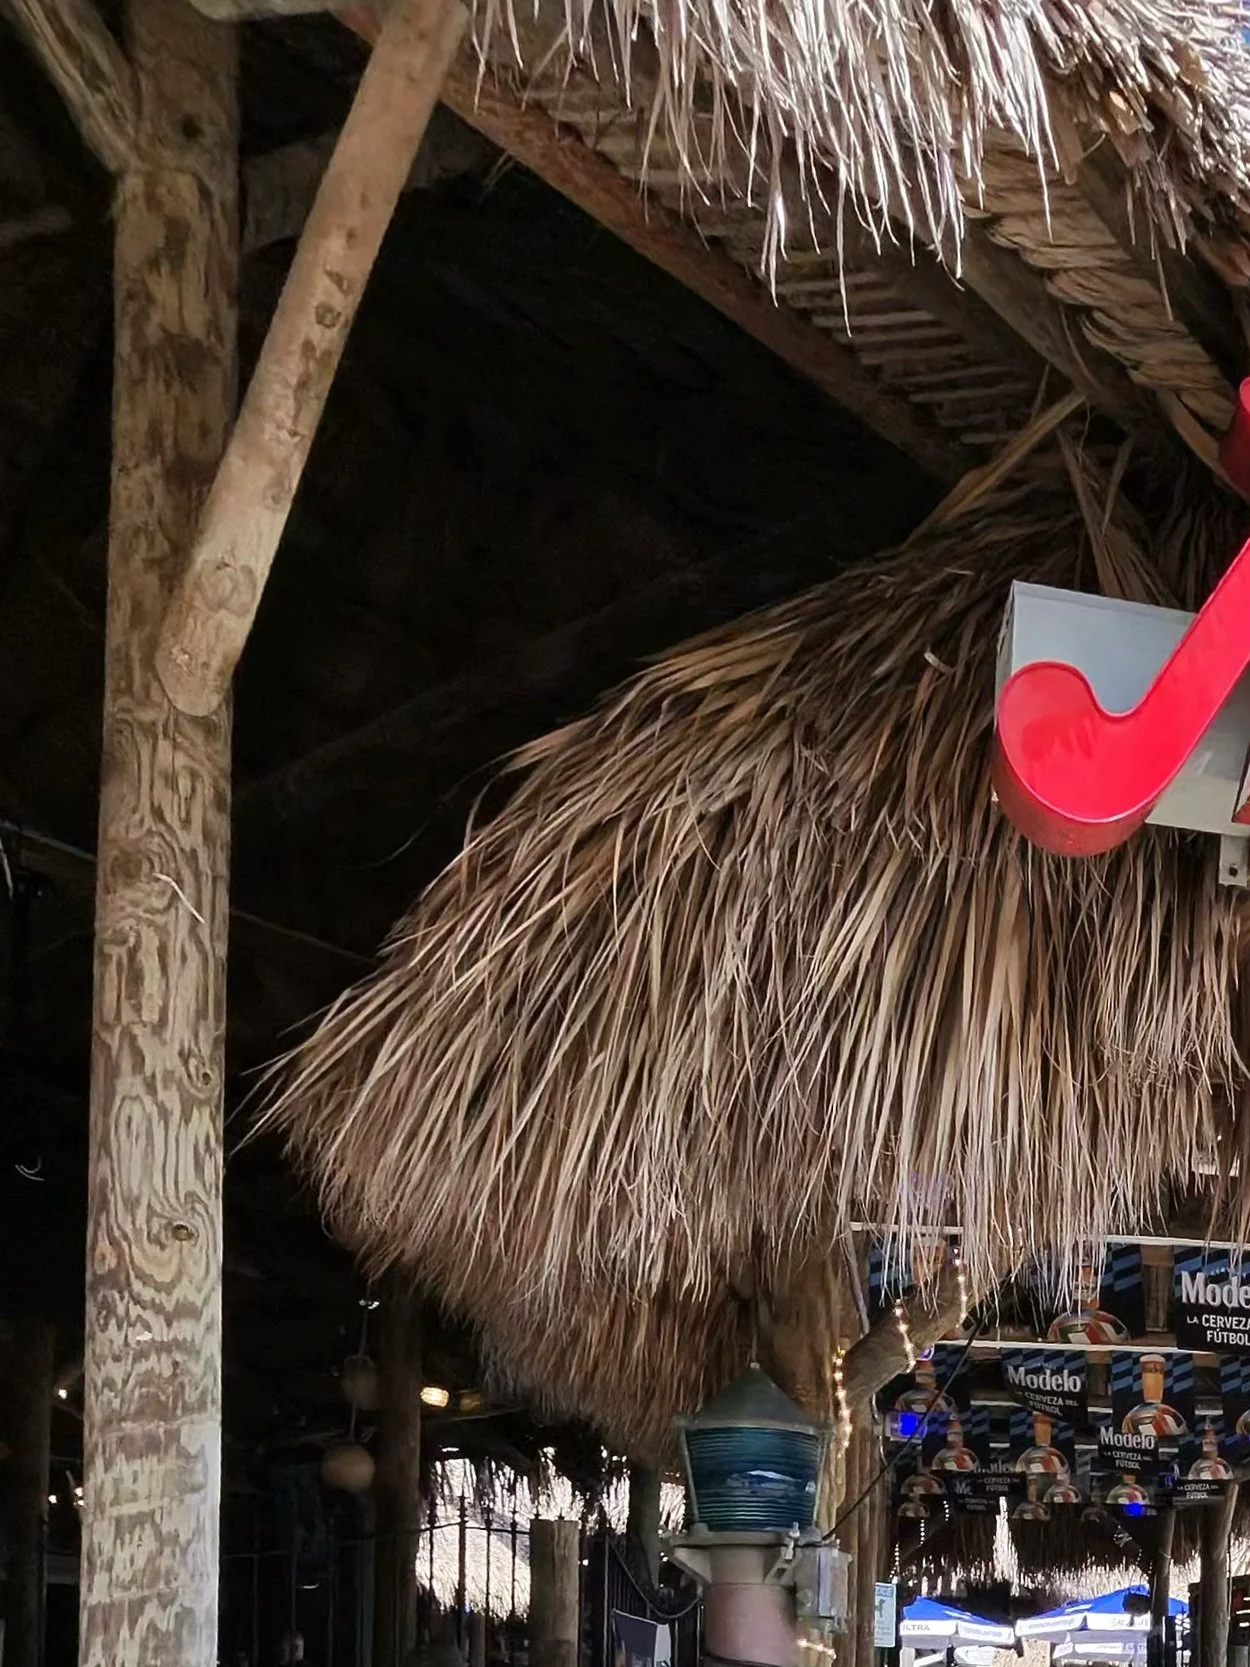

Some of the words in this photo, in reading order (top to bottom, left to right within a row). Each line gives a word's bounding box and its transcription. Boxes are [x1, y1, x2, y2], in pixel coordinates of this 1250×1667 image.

[1187, 1315, 1199, 1324] LA
[1007, 1364, 1082, 1392] Modelo
[1100, 1426, 1155, 1449] Modelo
